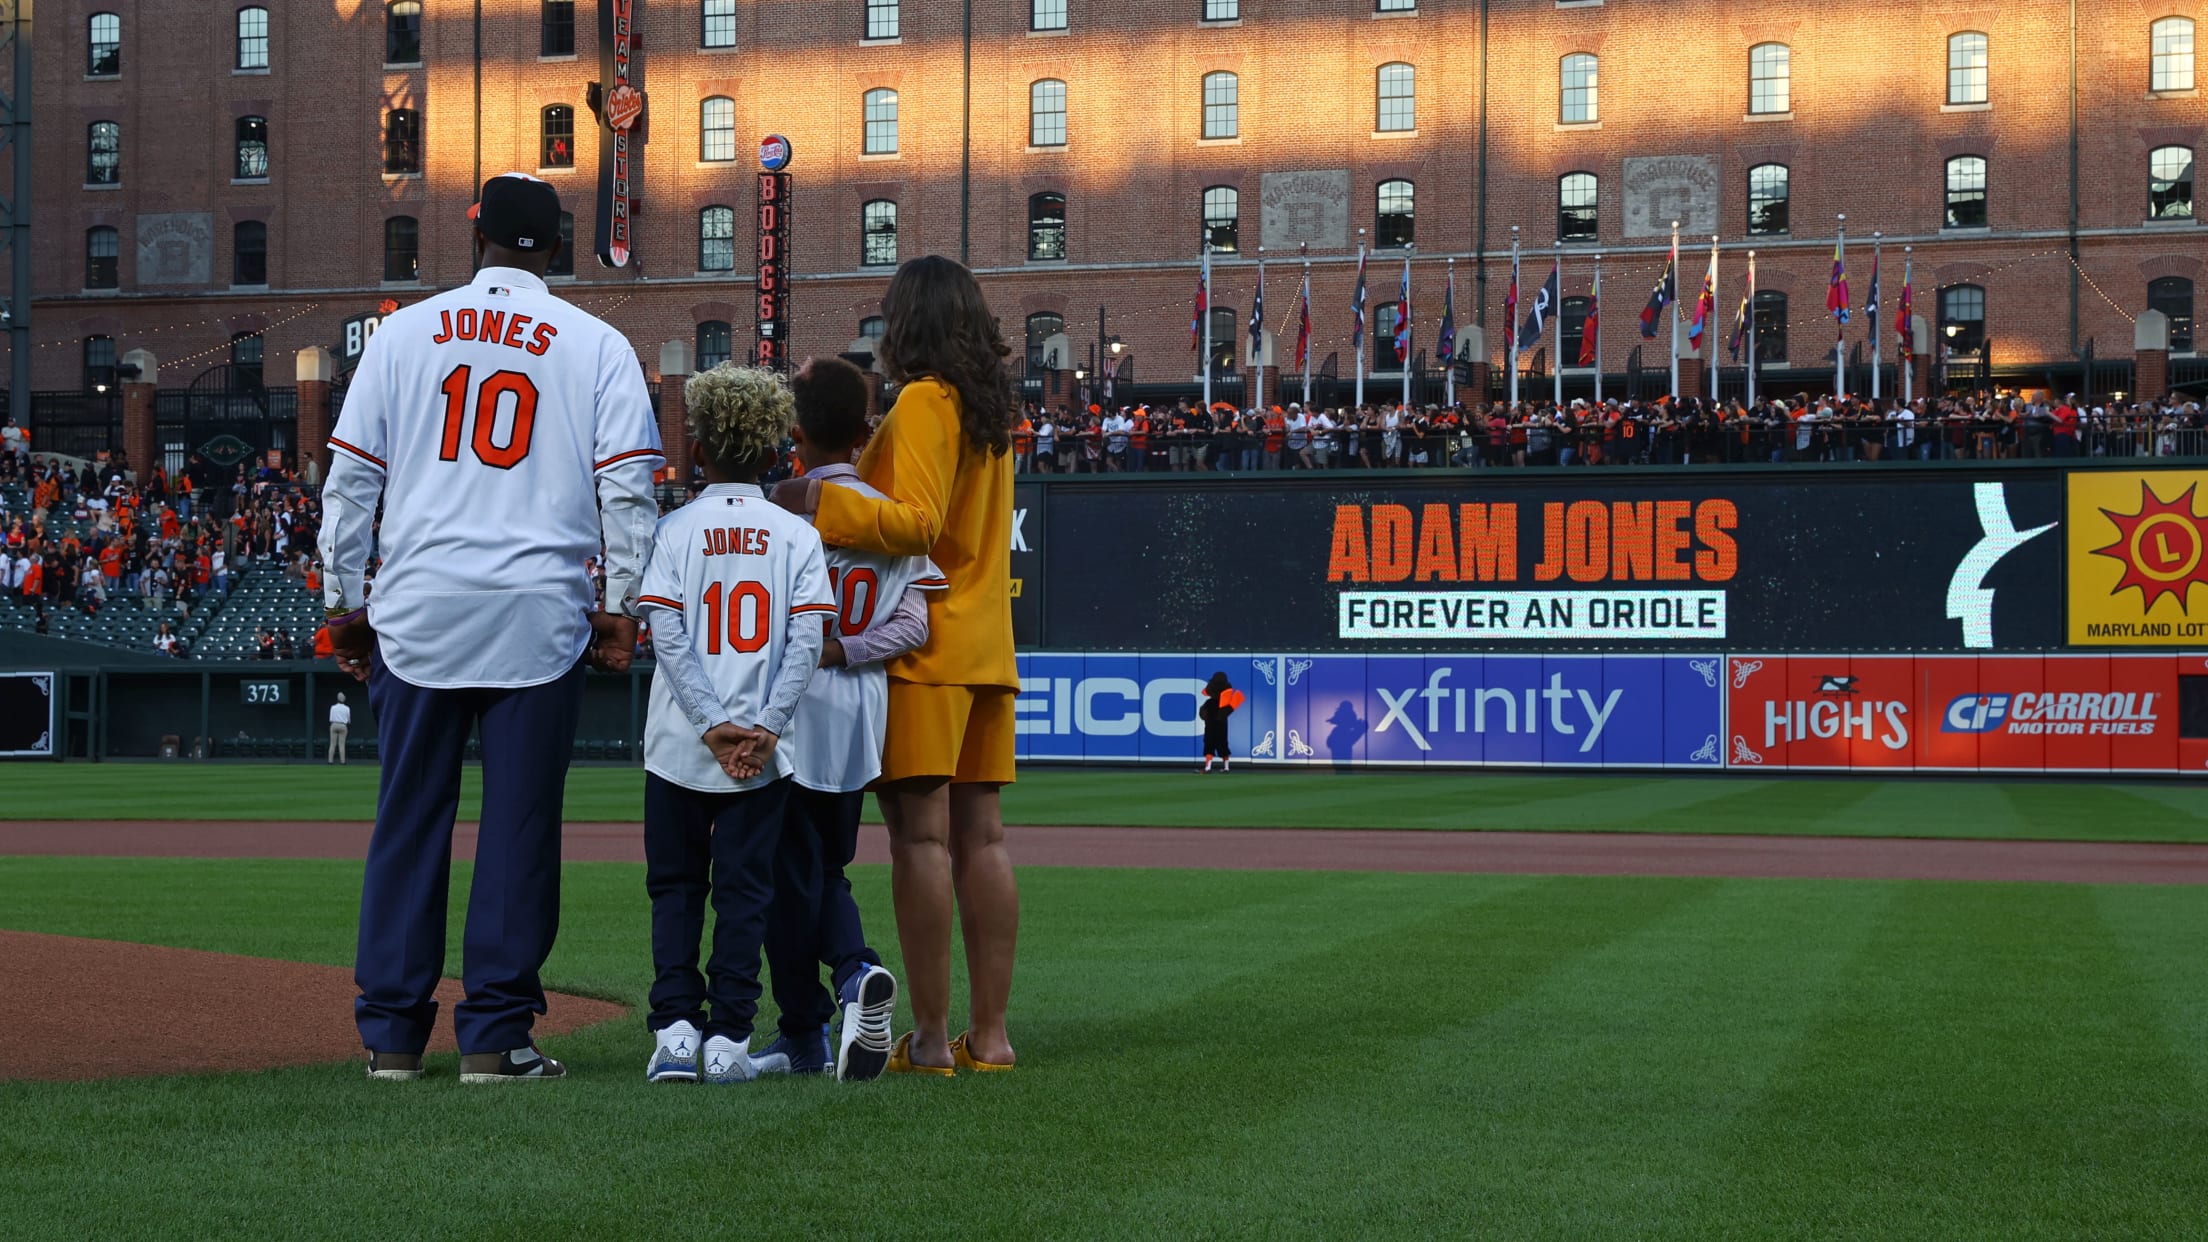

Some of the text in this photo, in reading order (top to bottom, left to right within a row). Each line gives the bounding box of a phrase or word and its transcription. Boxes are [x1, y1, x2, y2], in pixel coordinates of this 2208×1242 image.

[616, 0, 631, 80] TEAM
[615, 135, 628, 241] STORE
[346, 316, 388, 357] BO
[433, 308, 558, 356] JONES
[439, 363, 539, 471] 10
[1623, 425, 1634, 438] 10
[702, 527, 770, 556] JONES
[1327, 499, 1738, 582] ADAM JONES
[703, 580, 771, 655] 10
[1348, 598, 1718, 628] FOREVER AN ORIOLE
[2087, 623, 2171, 637] MARYLAND
[247, 684, 280, 702] 373
[1015, 677, 1208, 737] EICO
[1374, 667, 1623, 752] xfinity
[2011, 692, 2158, 721] CARROLL
[1765, 700, 1909, 750] HIGH'S
[2008, 722, 2154, 735] MOTOR FUELS
